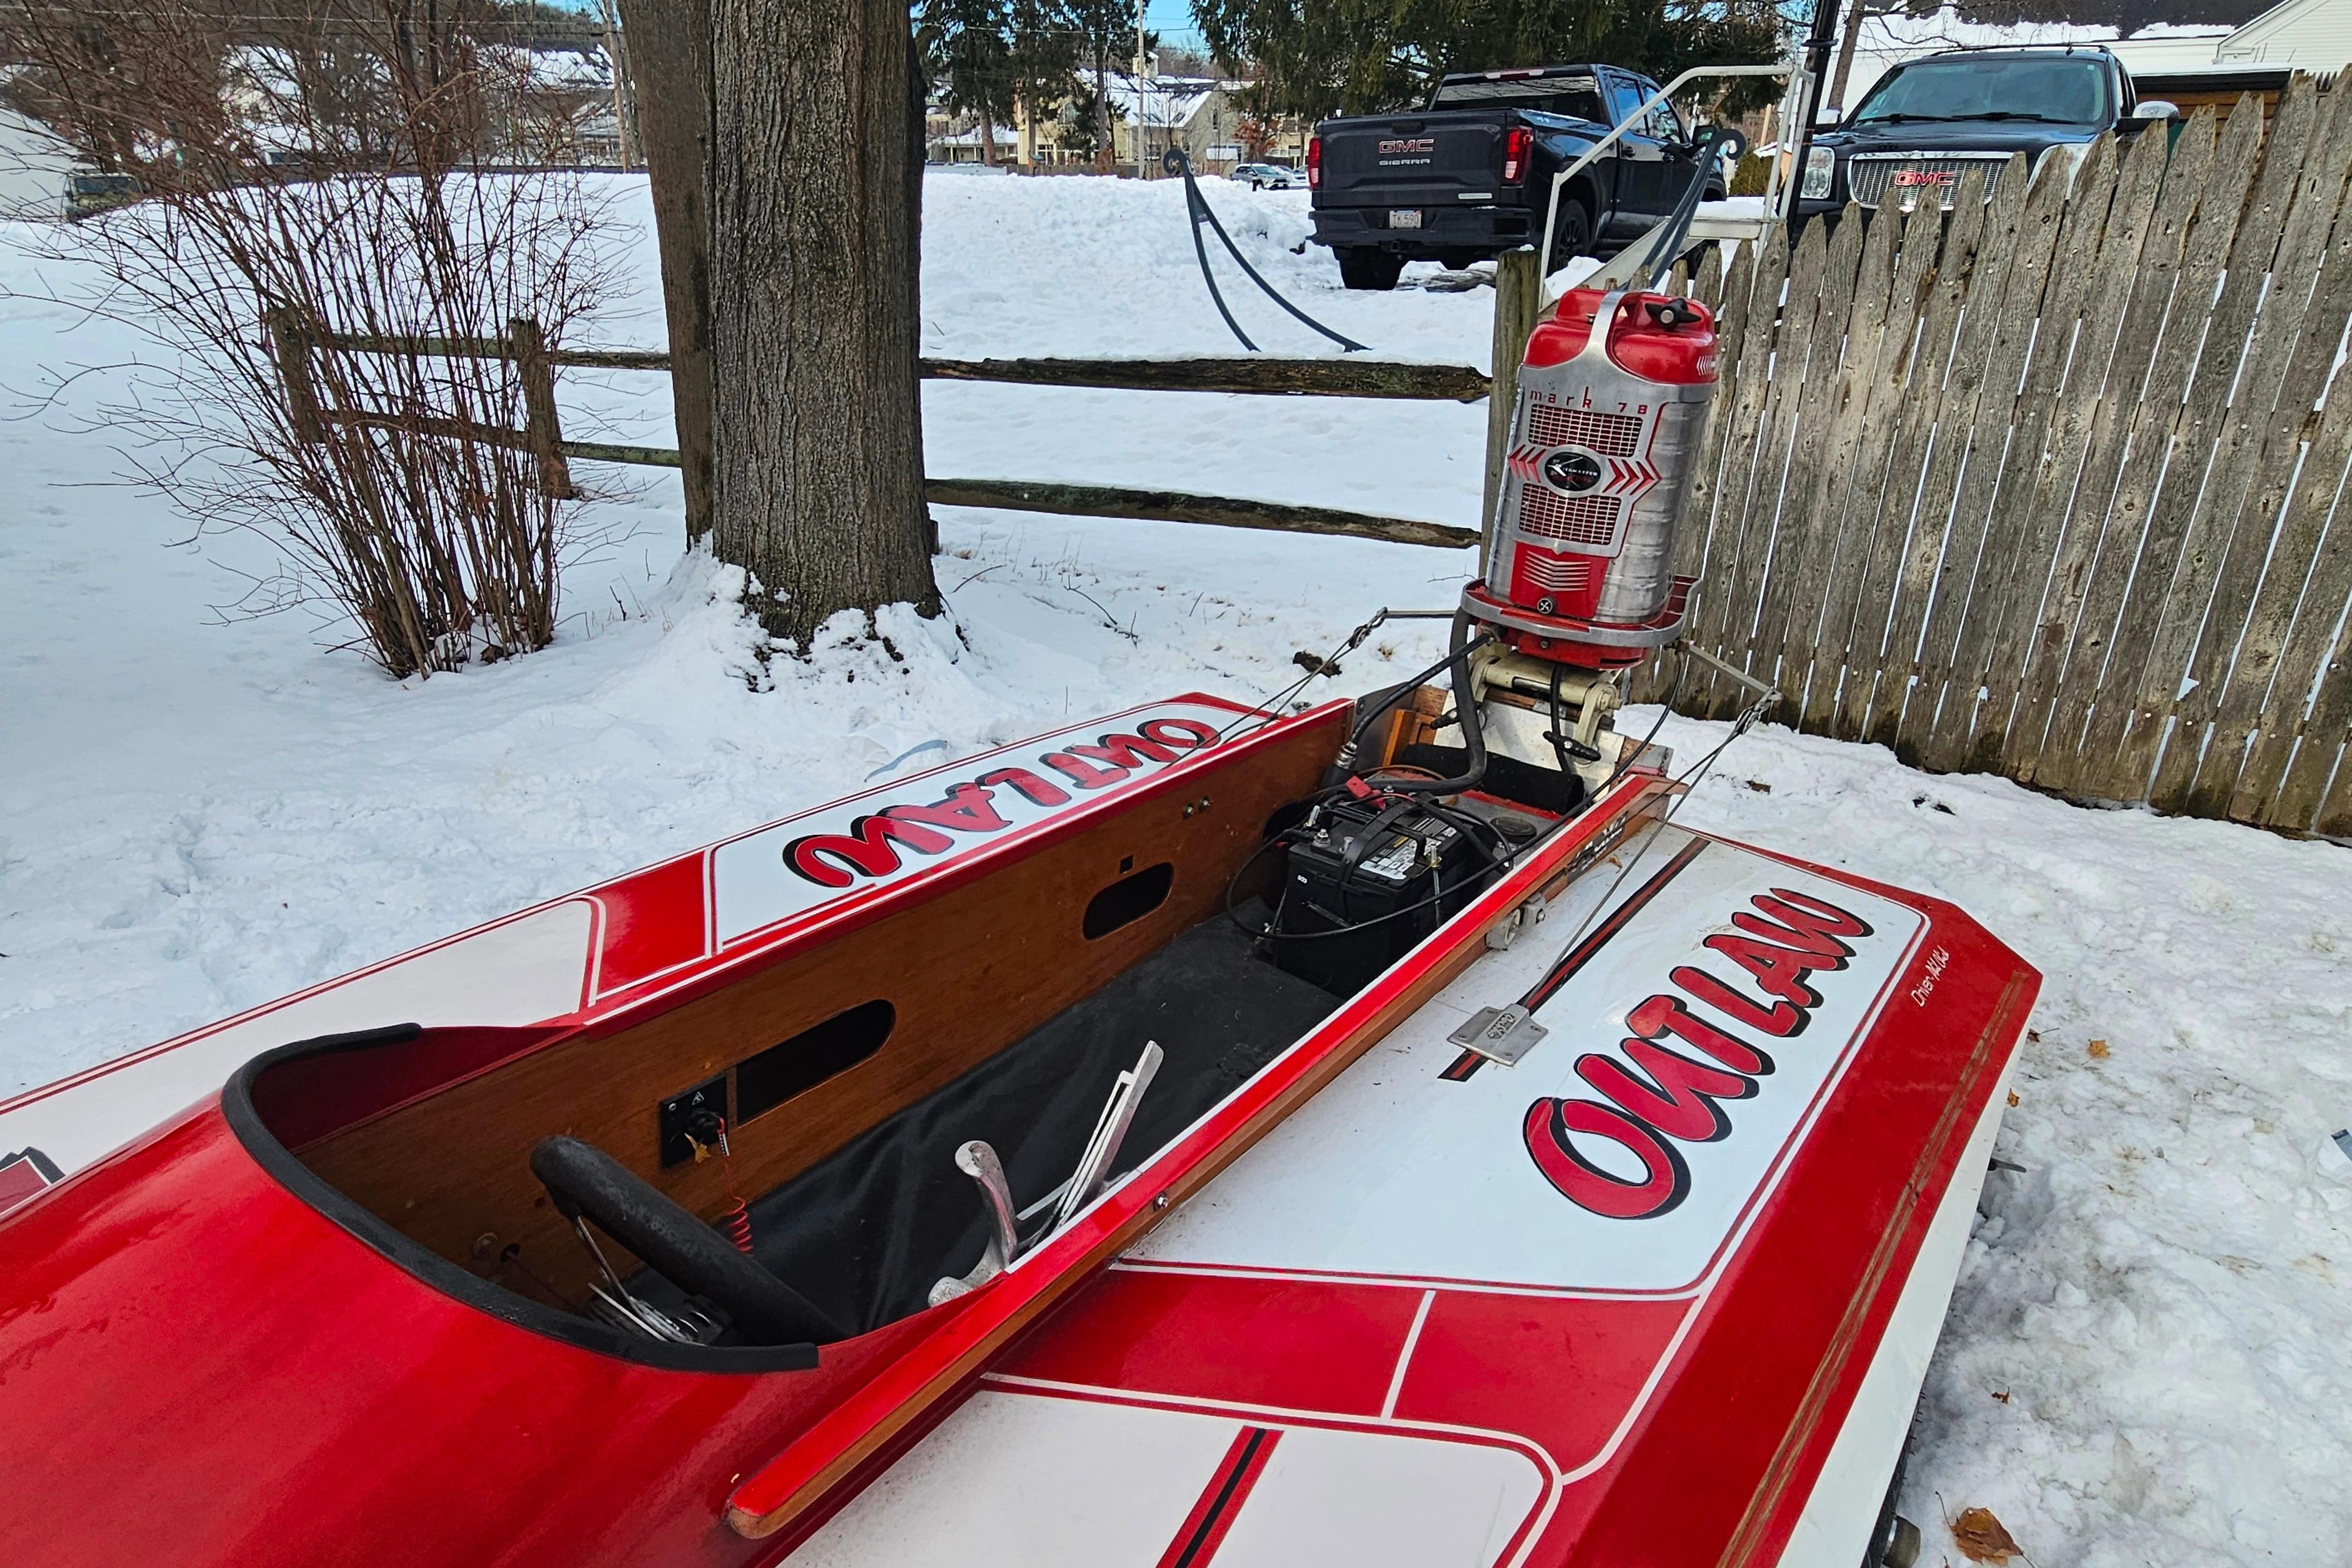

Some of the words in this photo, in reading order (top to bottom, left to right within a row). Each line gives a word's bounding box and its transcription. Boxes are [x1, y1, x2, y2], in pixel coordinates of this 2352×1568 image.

[1379, 139, 1434, 153] GMC
[1894, 170, 1955, 186] GMC
[1530, 386, 1592, 409] mark
[1618, 402, 1648, 415] 78
[783, 718, 1222, 888] OUTLAW
[1522, 887, 1875, 1221] OUTLAW
